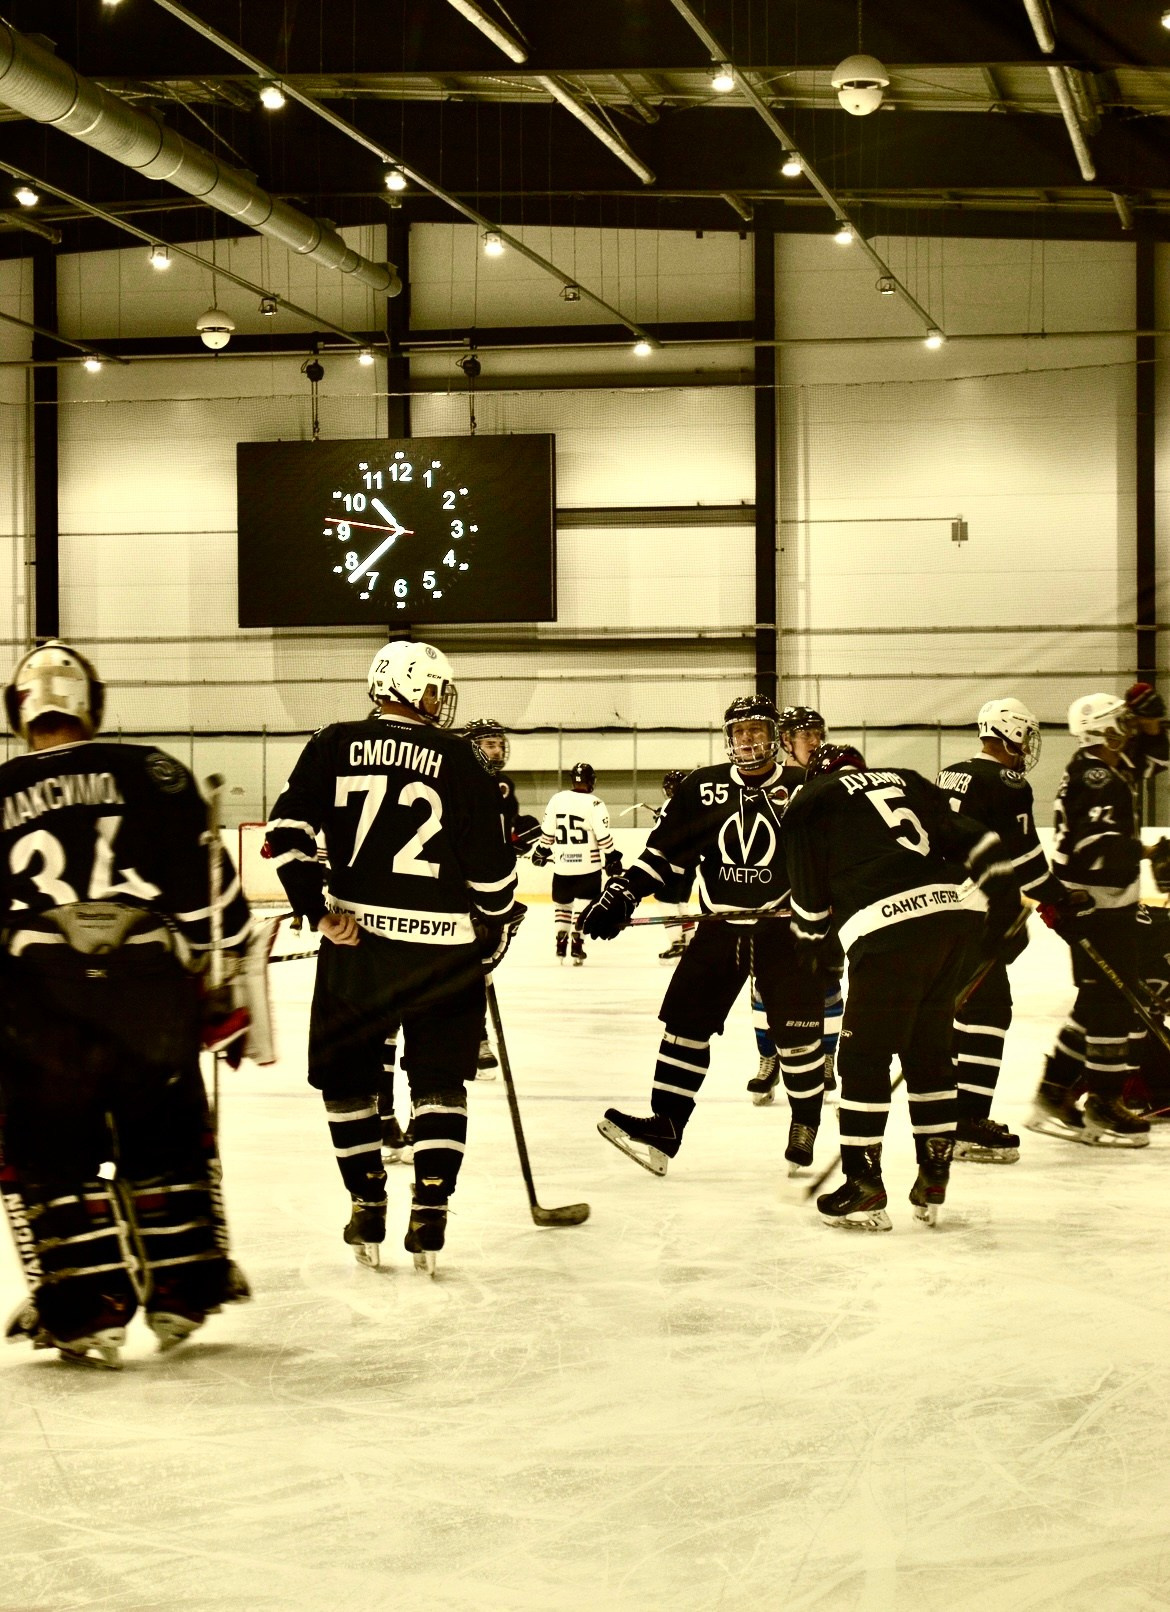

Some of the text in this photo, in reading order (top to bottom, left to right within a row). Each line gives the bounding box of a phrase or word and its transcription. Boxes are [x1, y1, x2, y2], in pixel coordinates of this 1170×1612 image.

[362, 471, 383, 490] 11
[388, 462, 413, 482] 12
[422, 469, 432, 489] 1
[342, 492, 367, 512] 10
[442, 490, 456, 510] 2
[336, 521, 351, 542] 9
[450, 519, 464, 539] 3
[344, 551, 359, 571] 8
[442, 548, 457, 568] 4
[365, 571, 380, 591] 7
[393, 578, 408, 598] 6
[422, 570, 436, 590] 5
[375, 659, 390, 674] 72
[350, 738, 443, 778] СМОЛИН
[838, 771, 907, 796] ДУДИН
[699, 782, 730, 806] 55
[334, 774, 443, 879] 72
[555, 813, 589, 845] 55
[864, 785, 931, 857] 5
[1016, 812, 1029, 835] 7
[718, 866, 773, 884] МЕТРО
[785, 1020, 821, 1028] BAUER
